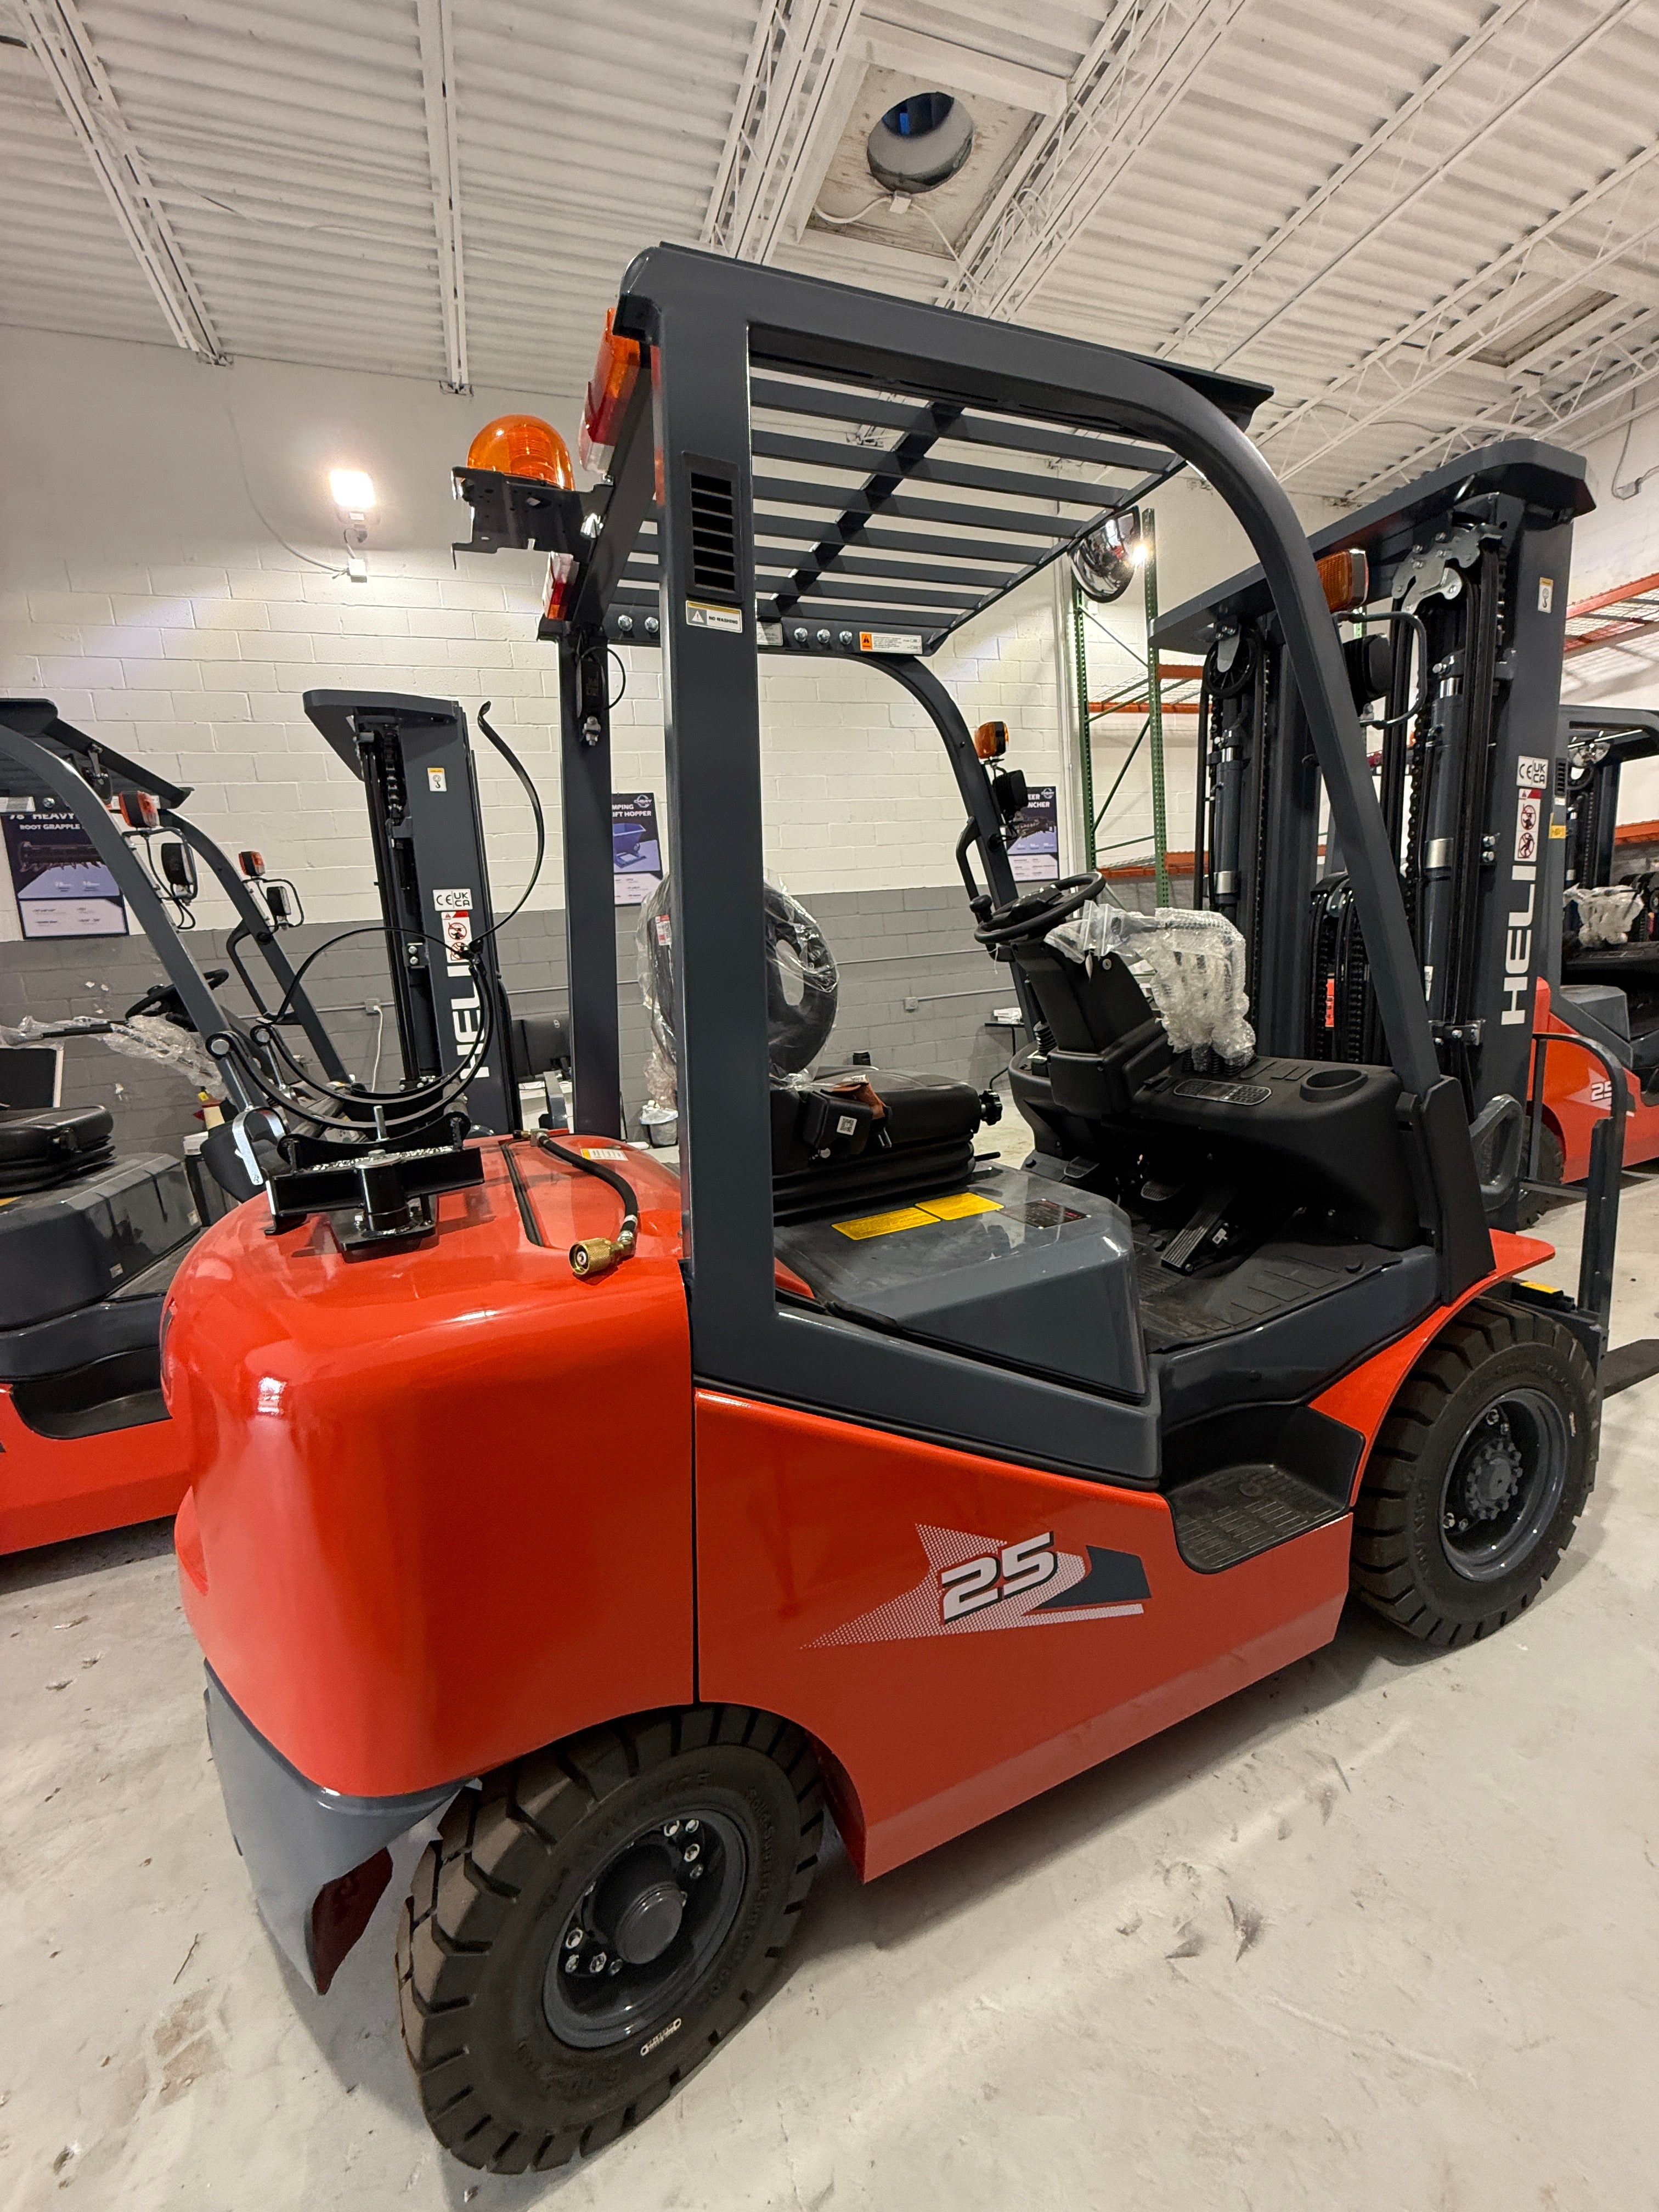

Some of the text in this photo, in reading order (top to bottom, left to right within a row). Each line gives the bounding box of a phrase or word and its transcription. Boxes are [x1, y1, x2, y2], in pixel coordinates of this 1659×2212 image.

[1519, 763, 1532, 780] CE
[1534, 763, 1546, 774] UK
[1533, 774, 1545, 784] CA
[436, 894, 453, 906] CE
[454, 891, 469, 900] UK
[1501, 865, 1536, 1025] HELI
[447, 964, 490, 1080] HELI
[941, 1531, 1058, 1624] 25
